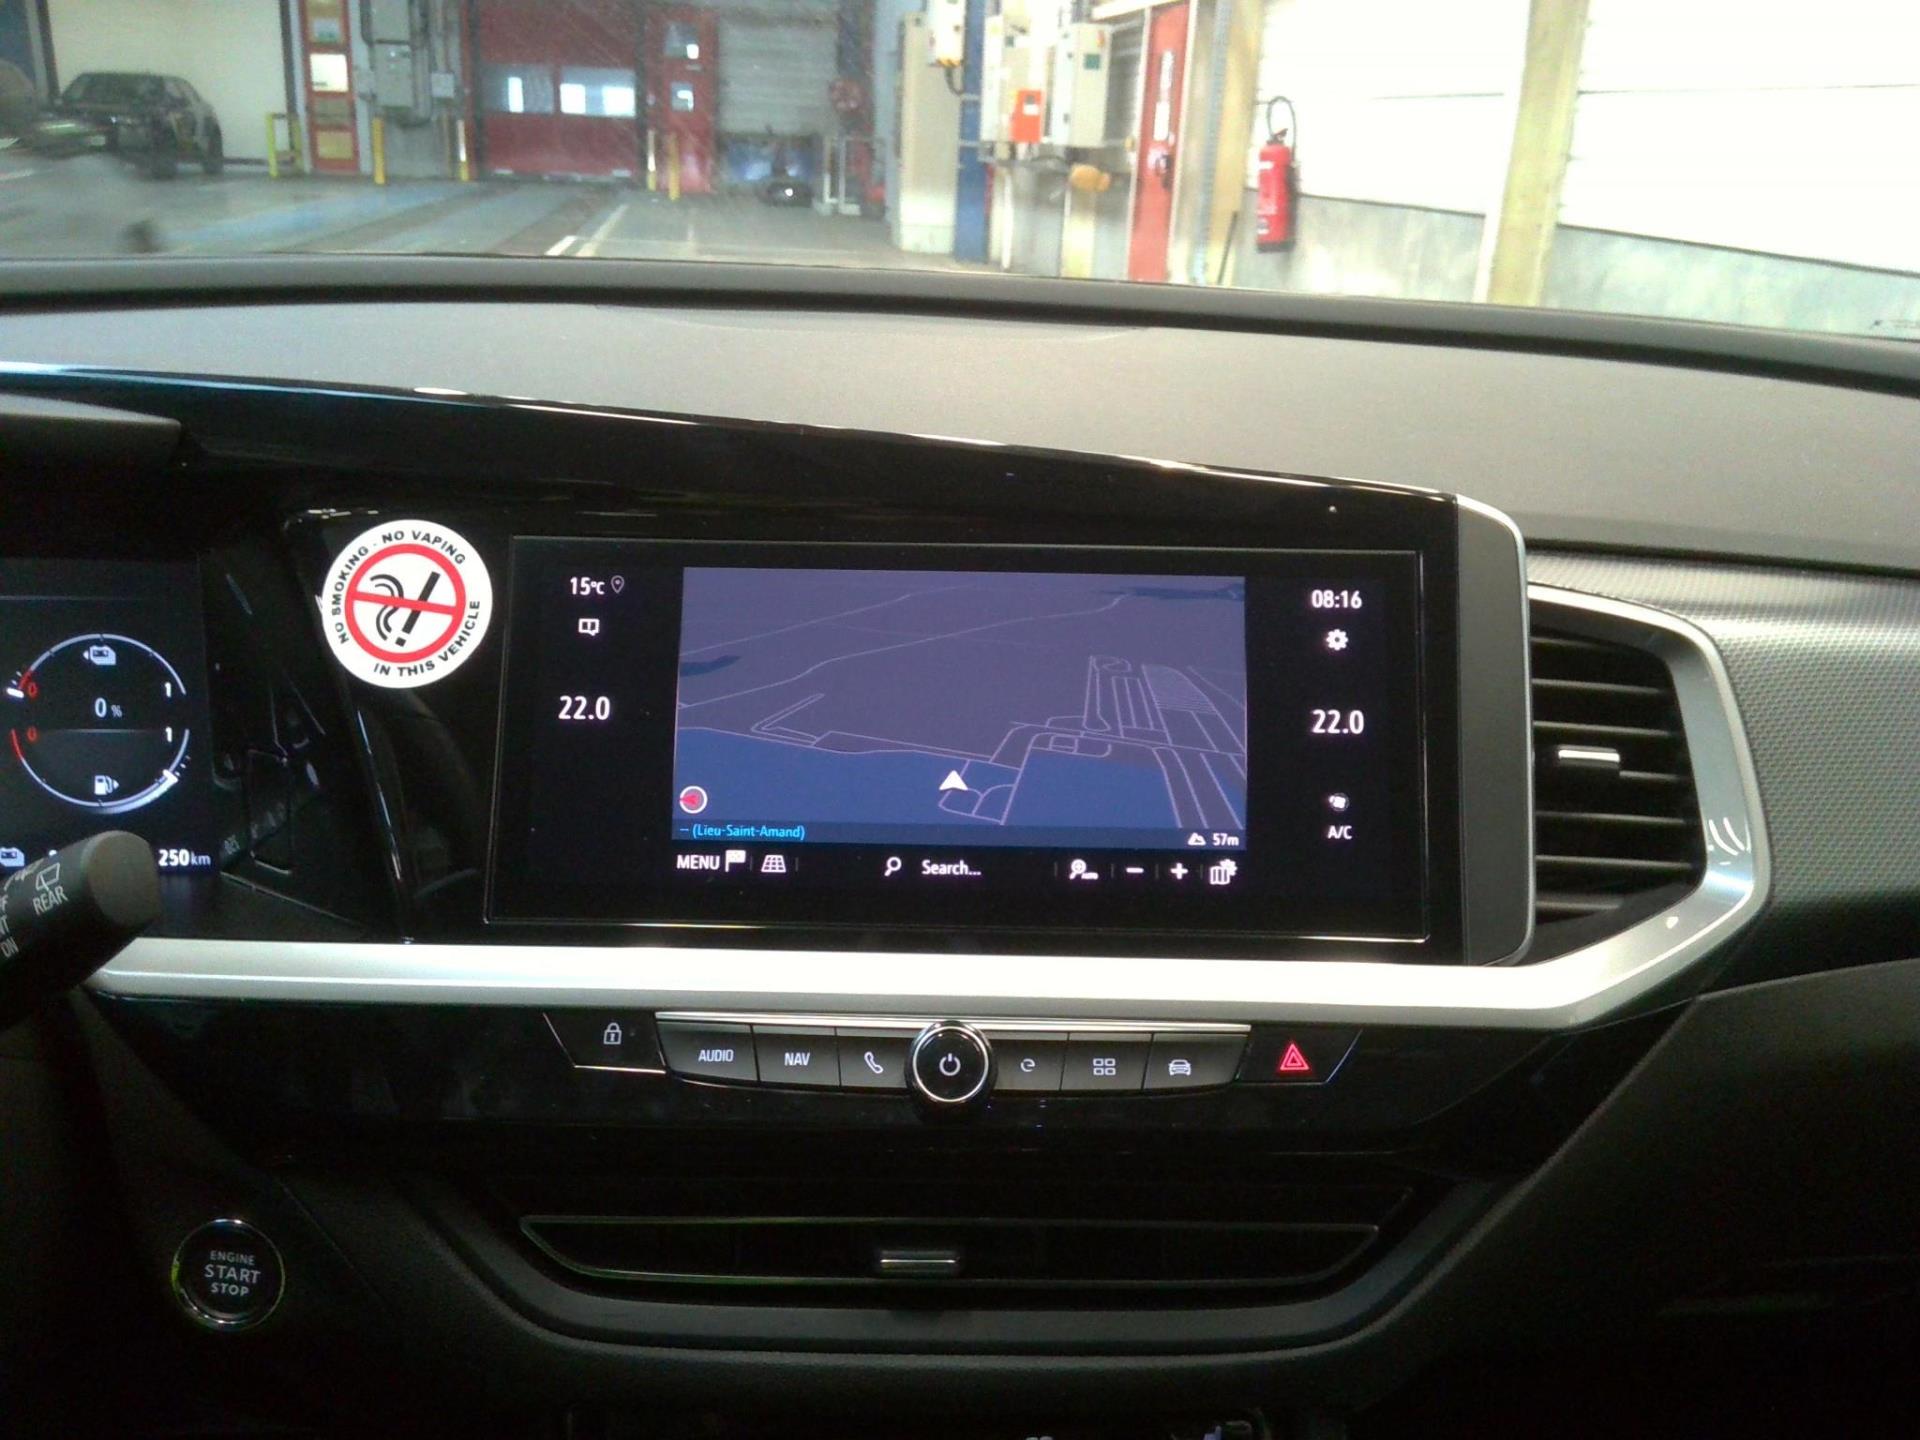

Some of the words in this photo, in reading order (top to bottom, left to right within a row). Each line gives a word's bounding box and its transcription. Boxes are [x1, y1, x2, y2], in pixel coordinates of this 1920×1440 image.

[381, 530, 405, 544] NO
[411, 530, 467, 565] VAPING
[331, 546, 369, 616] SMOKING
[1311, 589, 1363, 609] 08:16
[334, 622, 350, 645] NO
[373, 662, 391, 676] IN
[397, 660, 435, 677] THIS
[438, 600, 481, 663] VEHICLE
[94, 697, 107, 718] 0
[558, 695, 611, 721] 22.0
[1311, 709, 1365, 735] 22.0
[692, 823, 805, 841] (Lieu-Saint-Amand)
[1327, 825, 1353, 840] A/C
[676, 854, 720, 870] MENU
[32, 886, 68, 916] REAR
[698, 1049, 734, 1063] AUDIO
[784, 1052, 811, 1066] NAV
[210, 1250, 256, 1266] ENGINE
[204, 1263, 261, 1284] START
[211, 1282, 250, 1297] STOP
